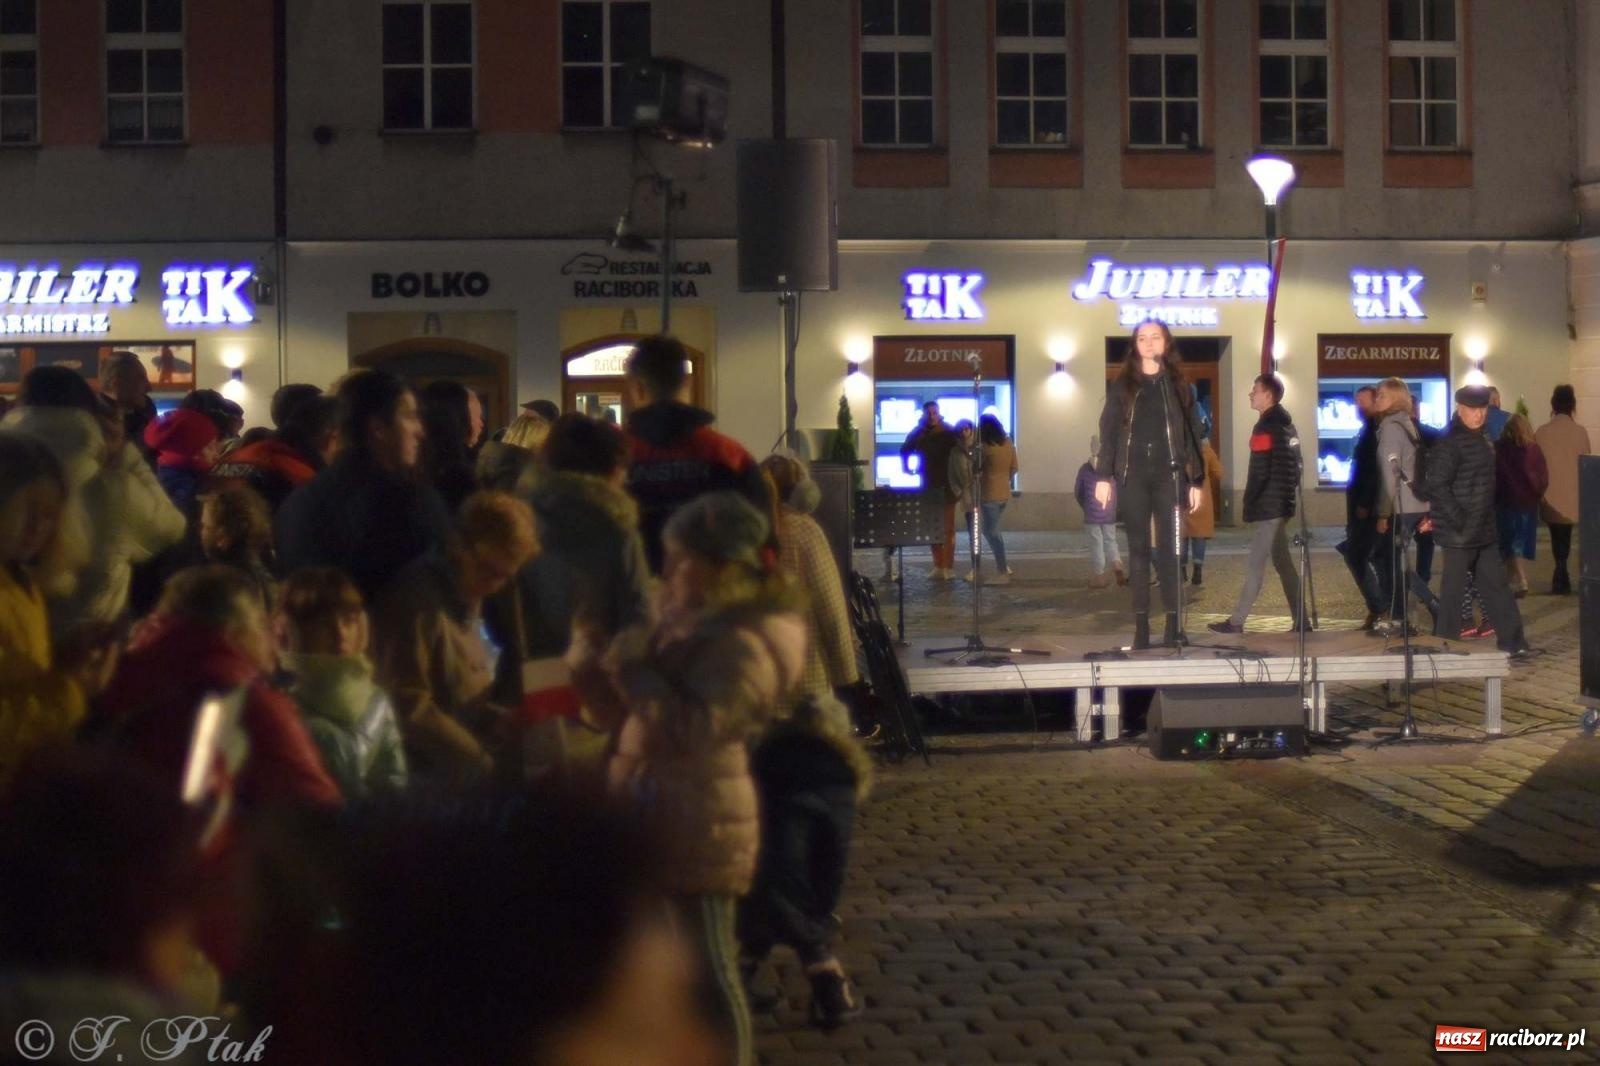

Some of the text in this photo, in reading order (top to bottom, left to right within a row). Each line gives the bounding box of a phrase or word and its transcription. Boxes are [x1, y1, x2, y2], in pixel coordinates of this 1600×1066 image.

[371, 271, 490, 298] BOLKO
[574, 280, 698, 298] RACIBORKA
[1325, 345, 1440, 360] ZEGARMISTRZ
